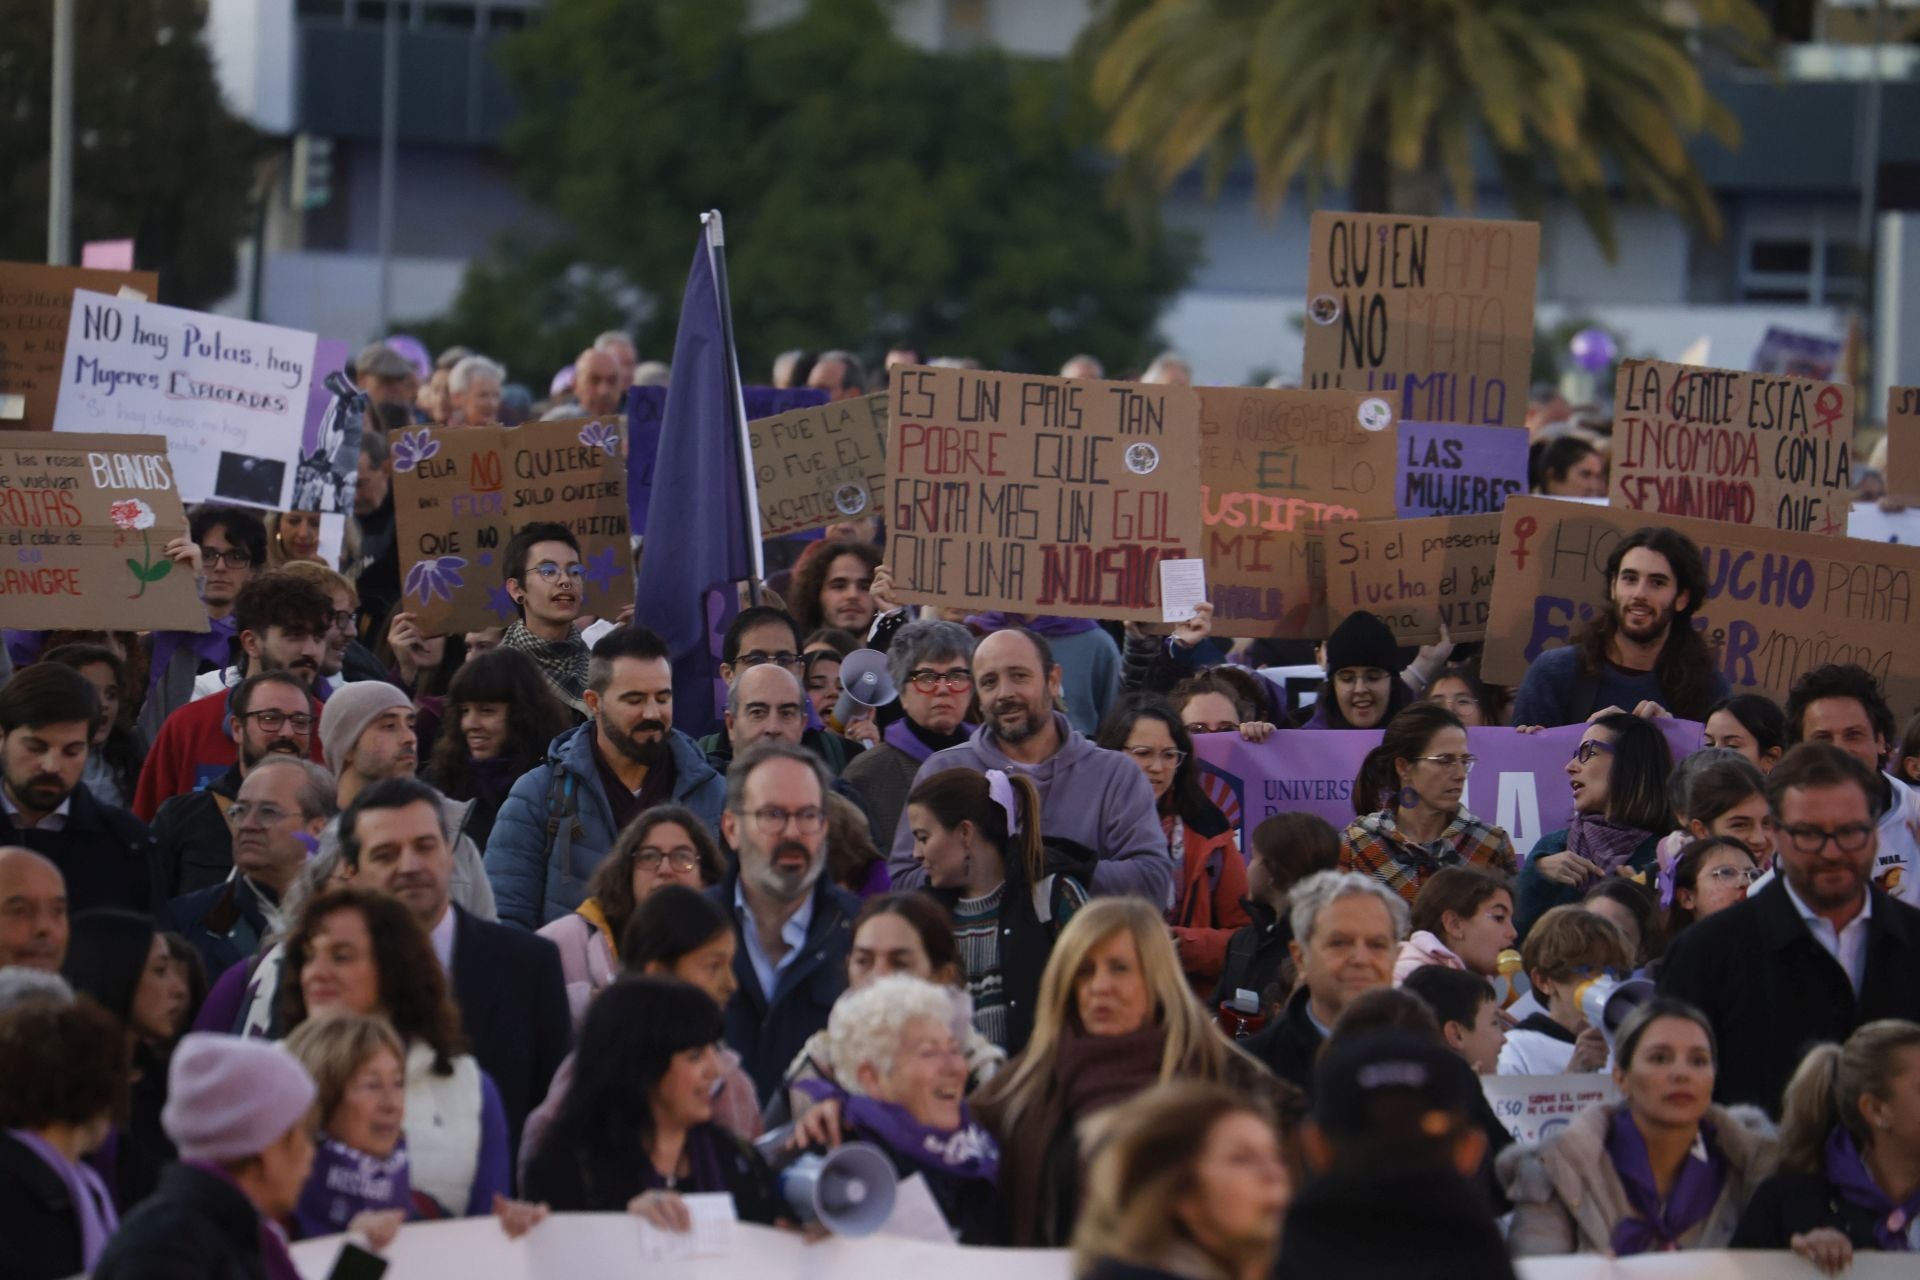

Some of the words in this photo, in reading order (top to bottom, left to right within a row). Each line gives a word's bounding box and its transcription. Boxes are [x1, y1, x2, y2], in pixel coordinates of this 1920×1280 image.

[1443, 229, 1512, 291] AMA
[83, 304, 122, 343] NO
[132, 314, 169, 361] hay
[266, 347, 303, 389] hay
[1339, 294, 1388, 369] NO
[1403, 292, 1506, 373] MATA
[900, 371, 936, 418] ES
[957, 376, 1000, 422] UN
[1020, 380, 1084, 429] PAÍS
[1110, 387, 1165, 435] TAN
[1236, 395, 1370, 447] ALCOHOL
[1624, 365, 1661, 415] LA
[1671, 370, 1739, 426] GENTE
[771, 418, 814, 449] FUE
[821, 409, 855, 435] LA
[900, 423, 1007, 477] POBRE
[1033, 433, 1114, 485] QUE
[1407, 434, 1463, 470] LAS
[1618, 417, 1760, 478] INCOMODA
[1774, 435, 1818, 488] CON
[1822, 439, 1850, 490] LA
[15, 452, 38, 467] las
[45, 454, 85, 467] rosas
[88, 451, 171, 490] BLANCAS
[20, 473, 80, 490] vuelvan
[417, 458, 457, 480] ELLA
[470, 450, 504, 487] NO
[514, 445, 602, 481] QUIERE
[756, 465, 777, 489] O
[784, 451, 827, 478] FUE
[834, 436, 870, 468] EL
[1256, 445, 1312, 490] ÉL
[1331, 455, 1377, 495] LO
[512, 488, 554, 508] SOLO
[561, 480, 620, 502] QUIERE
[894, 478, 971, 533] GRITA
[978, 482, 1040, 541] MAS
[1056, 490, 1094, 543] UN
[1112, 489, 1181, 543] GOL
[8, 529, 23, 546] el
[31, 531, 61, 546] color
[66, 531, 83, 546] de
[419, 532, 462, 557] QUE
[477, 525, 499, 550] NO
[1209, 530, 1275, 572] MÍ
[1338, 531, 1370, 565] Si
[1384, 532, 1405, 561] el
[891, 533, 953, 594] QUE
[965, 541, 1024, 600] UNA
[1349, 568, 1426, 605] lucha
[1439, 567, 1457, 596] el
[1823, 561, 1912, 625] PARA
